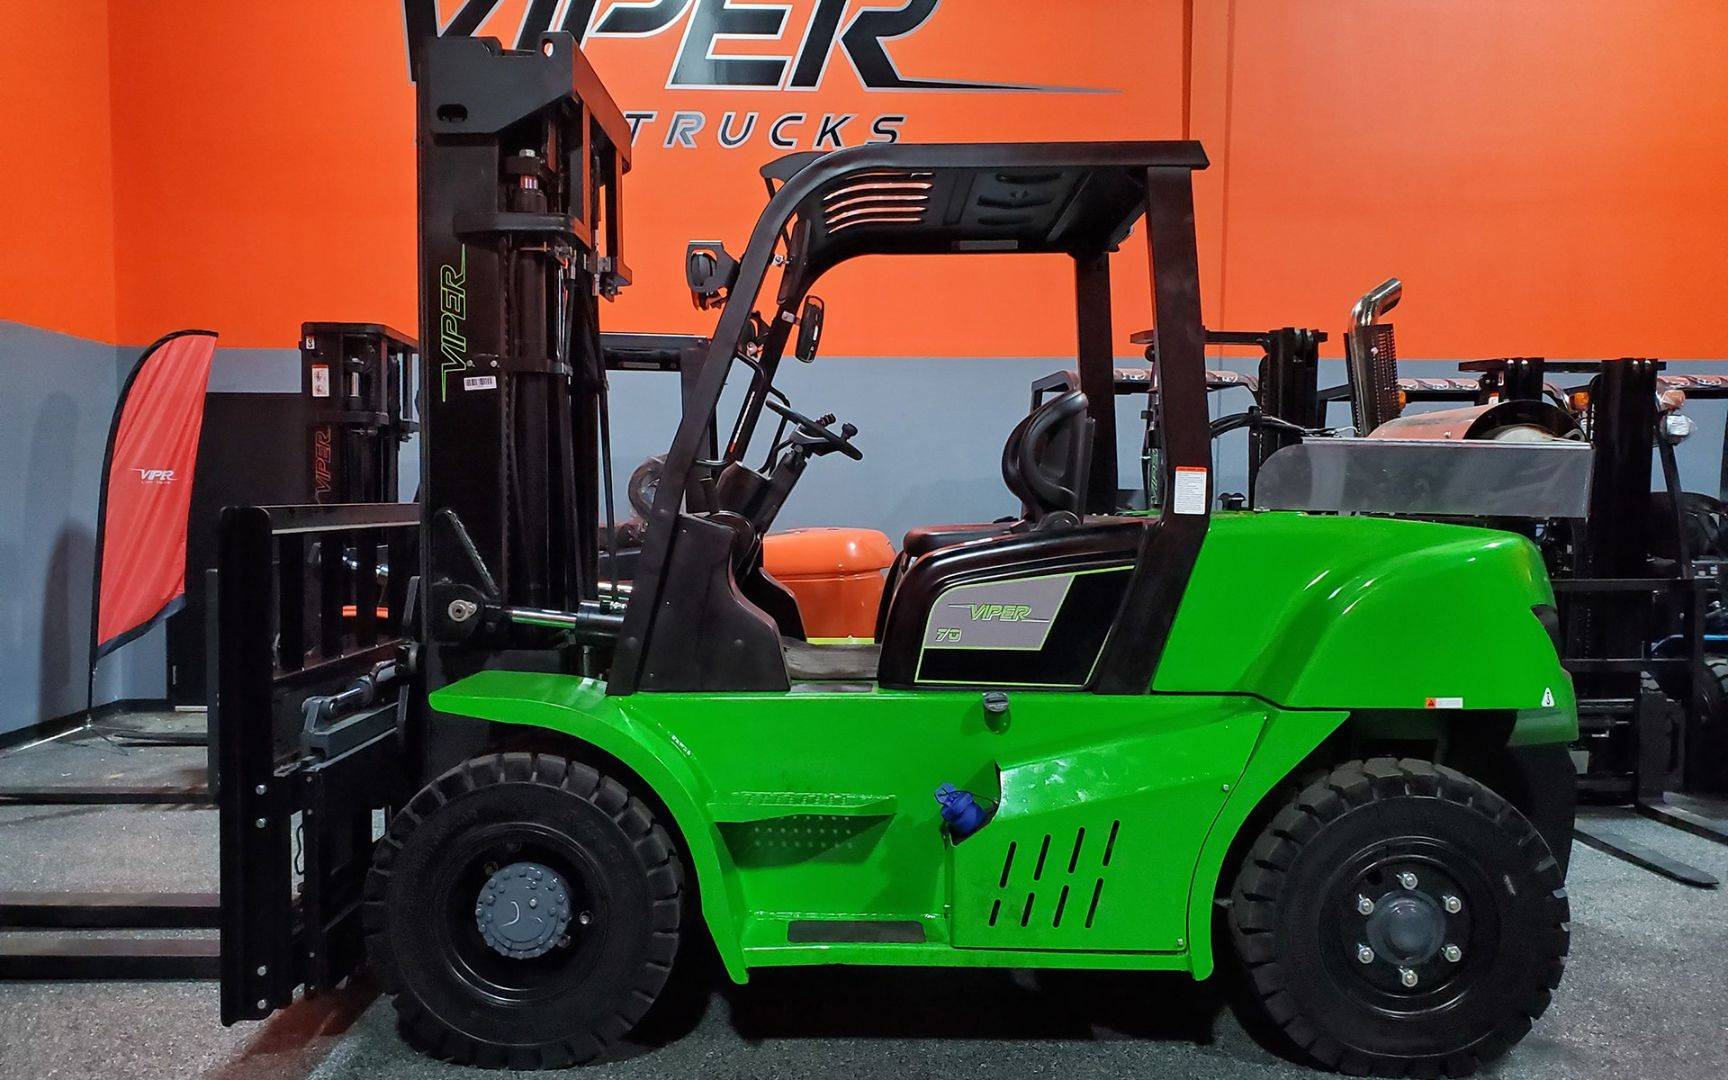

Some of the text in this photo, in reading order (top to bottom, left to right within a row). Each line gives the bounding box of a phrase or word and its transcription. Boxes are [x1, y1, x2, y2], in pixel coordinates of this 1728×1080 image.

[622, 110, 908, 149] TRUCKS
[440, 262, 467, 372] VIPER
[314, 430, 332, 494] VIPER
[967, 604, 1033, 622] VIPER
[935, 628, 962, 643] 70
